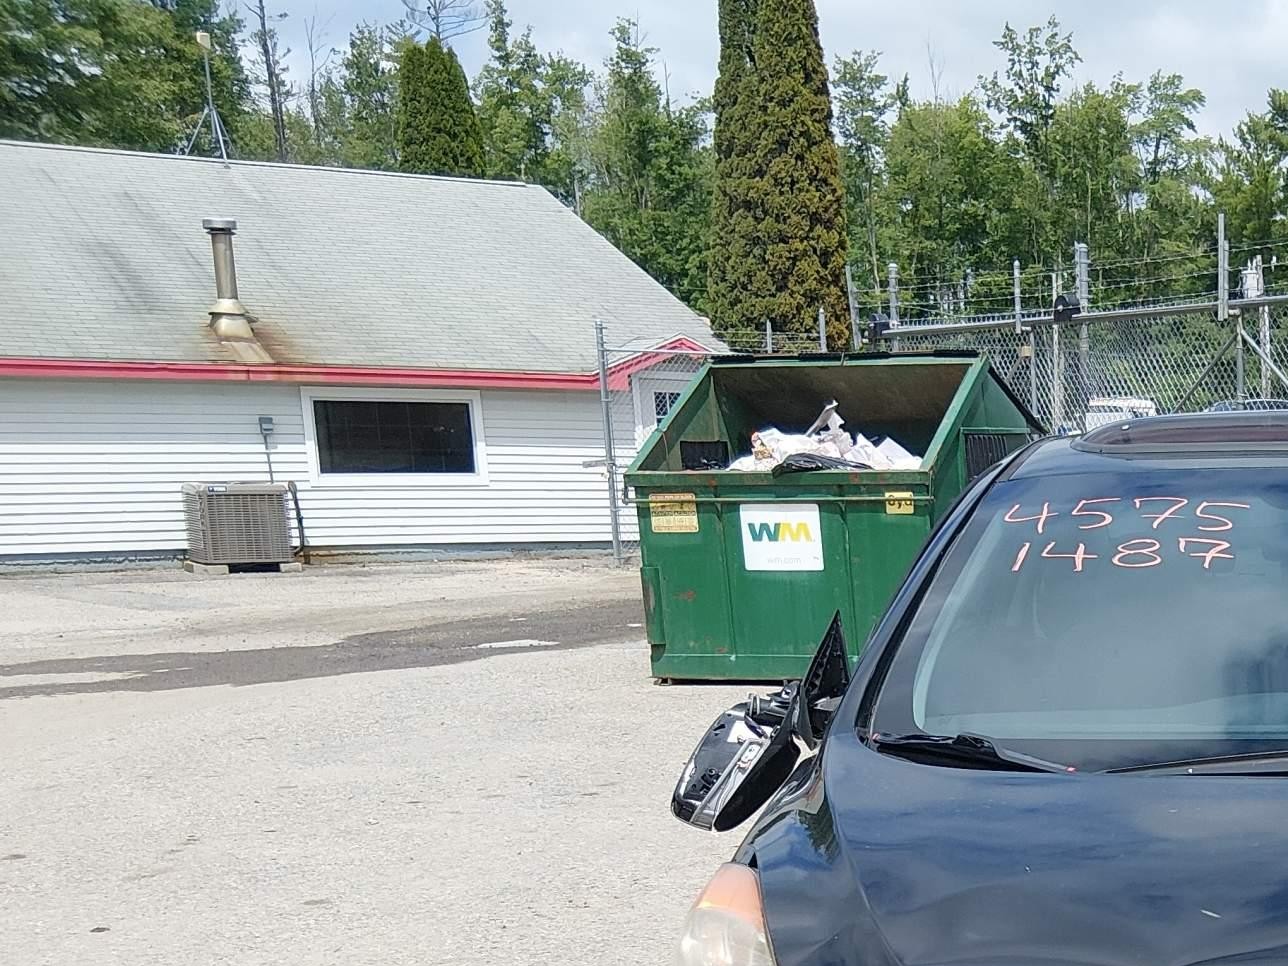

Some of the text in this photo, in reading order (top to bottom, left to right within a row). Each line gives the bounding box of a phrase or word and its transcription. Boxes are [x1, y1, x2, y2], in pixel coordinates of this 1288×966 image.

[747, 522, 812, 542] WM
[1004, 497, 1251, 534] 4575
[1011, 537, 1235, 572] 1487
